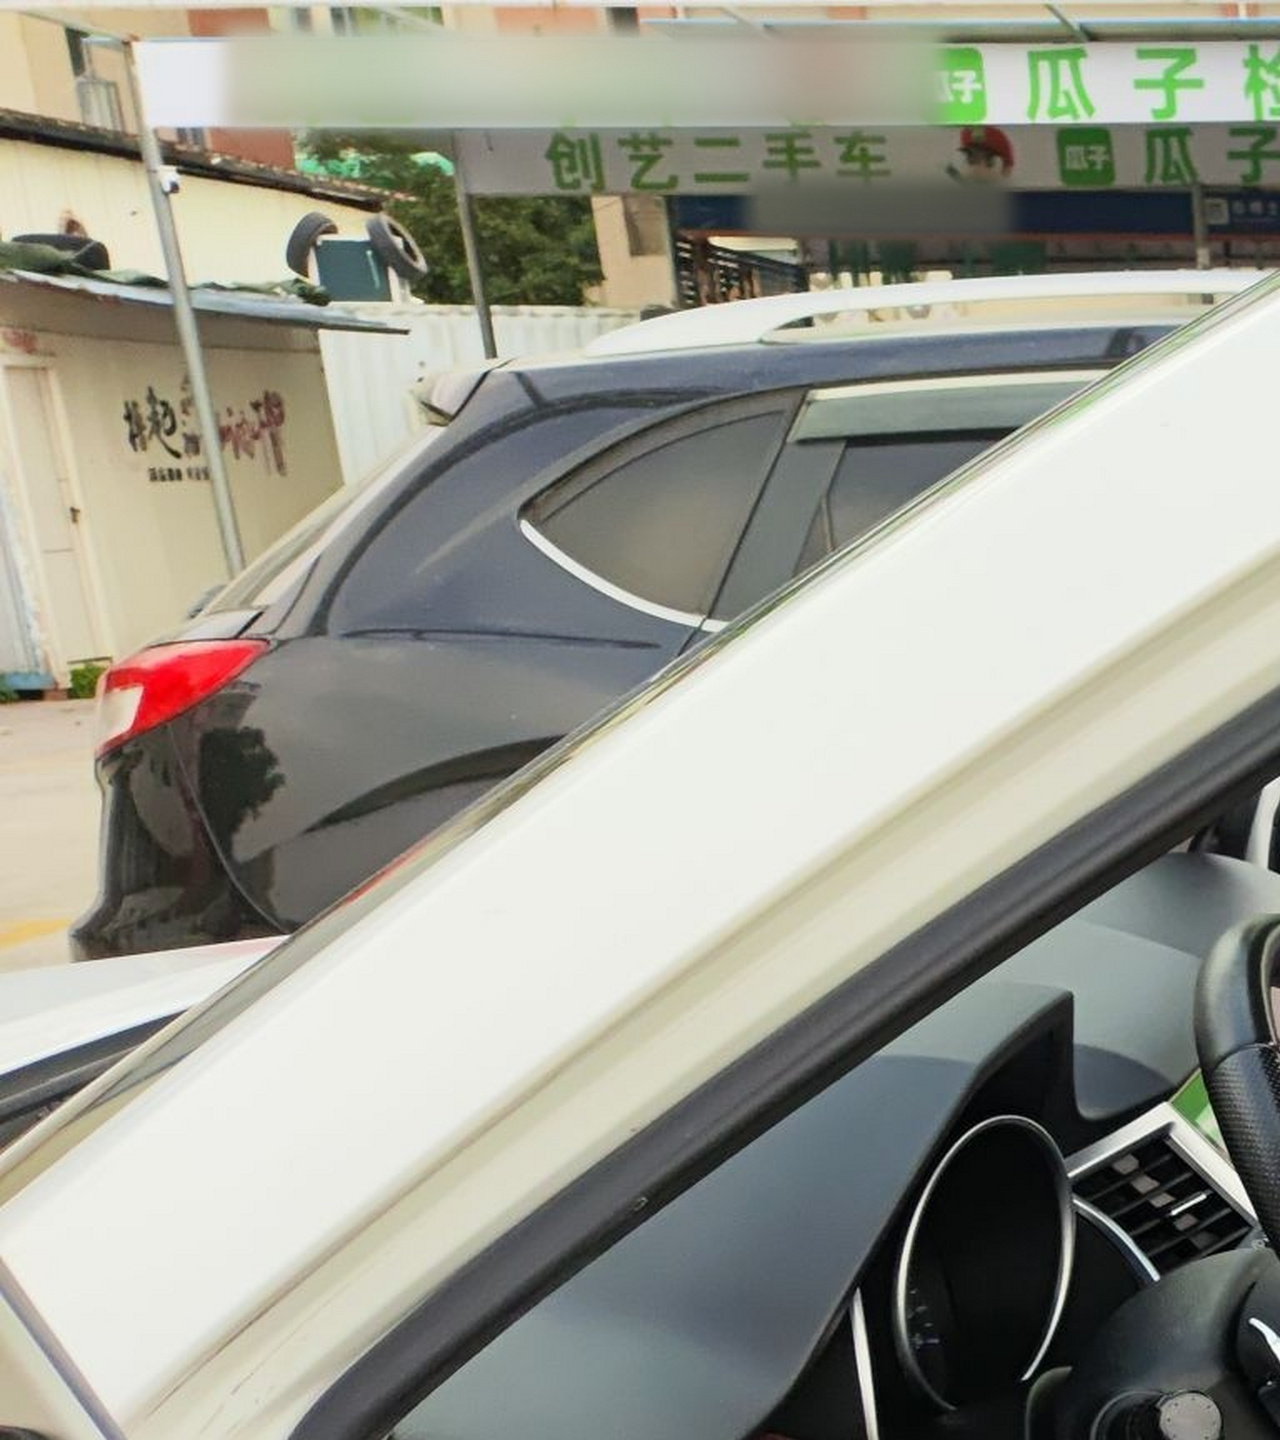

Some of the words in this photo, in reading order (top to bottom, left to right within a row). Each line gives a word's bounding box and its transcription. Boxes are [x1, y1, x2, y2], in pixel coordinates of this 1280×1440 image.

[545, 129, 892, 193] 创艺二手车
